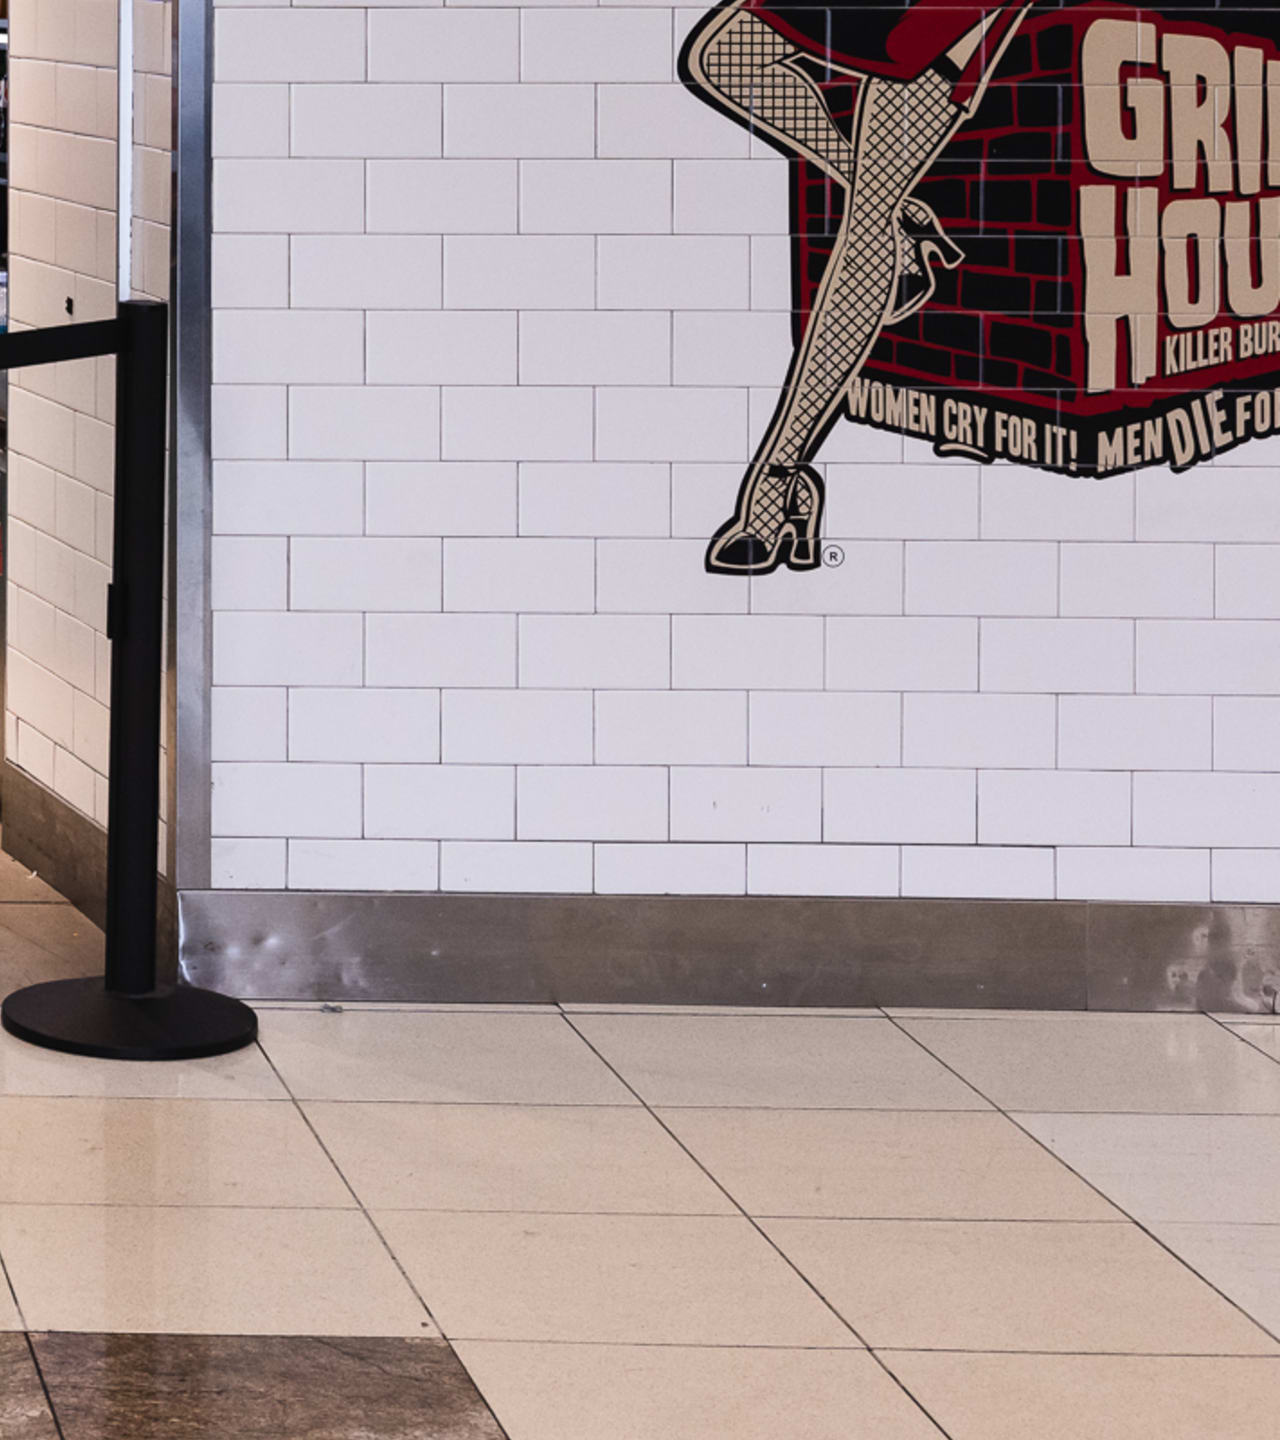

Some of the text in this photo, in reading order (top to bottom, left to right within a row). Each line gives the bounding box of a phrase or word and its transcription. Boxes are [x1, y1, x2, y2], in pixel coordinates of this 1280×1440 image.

[1164, 325, 1233, 376] KILLER
[846, 375, 937, 437] WOMEN
[942, 397, 989, 449] CRY
[993, 410, 1038, 463] FOR
[1044, 423, 1080, 473] IT!
[1096, 417, 1165, 474] MEN
[1165, 388, 1235, 468] DIE
